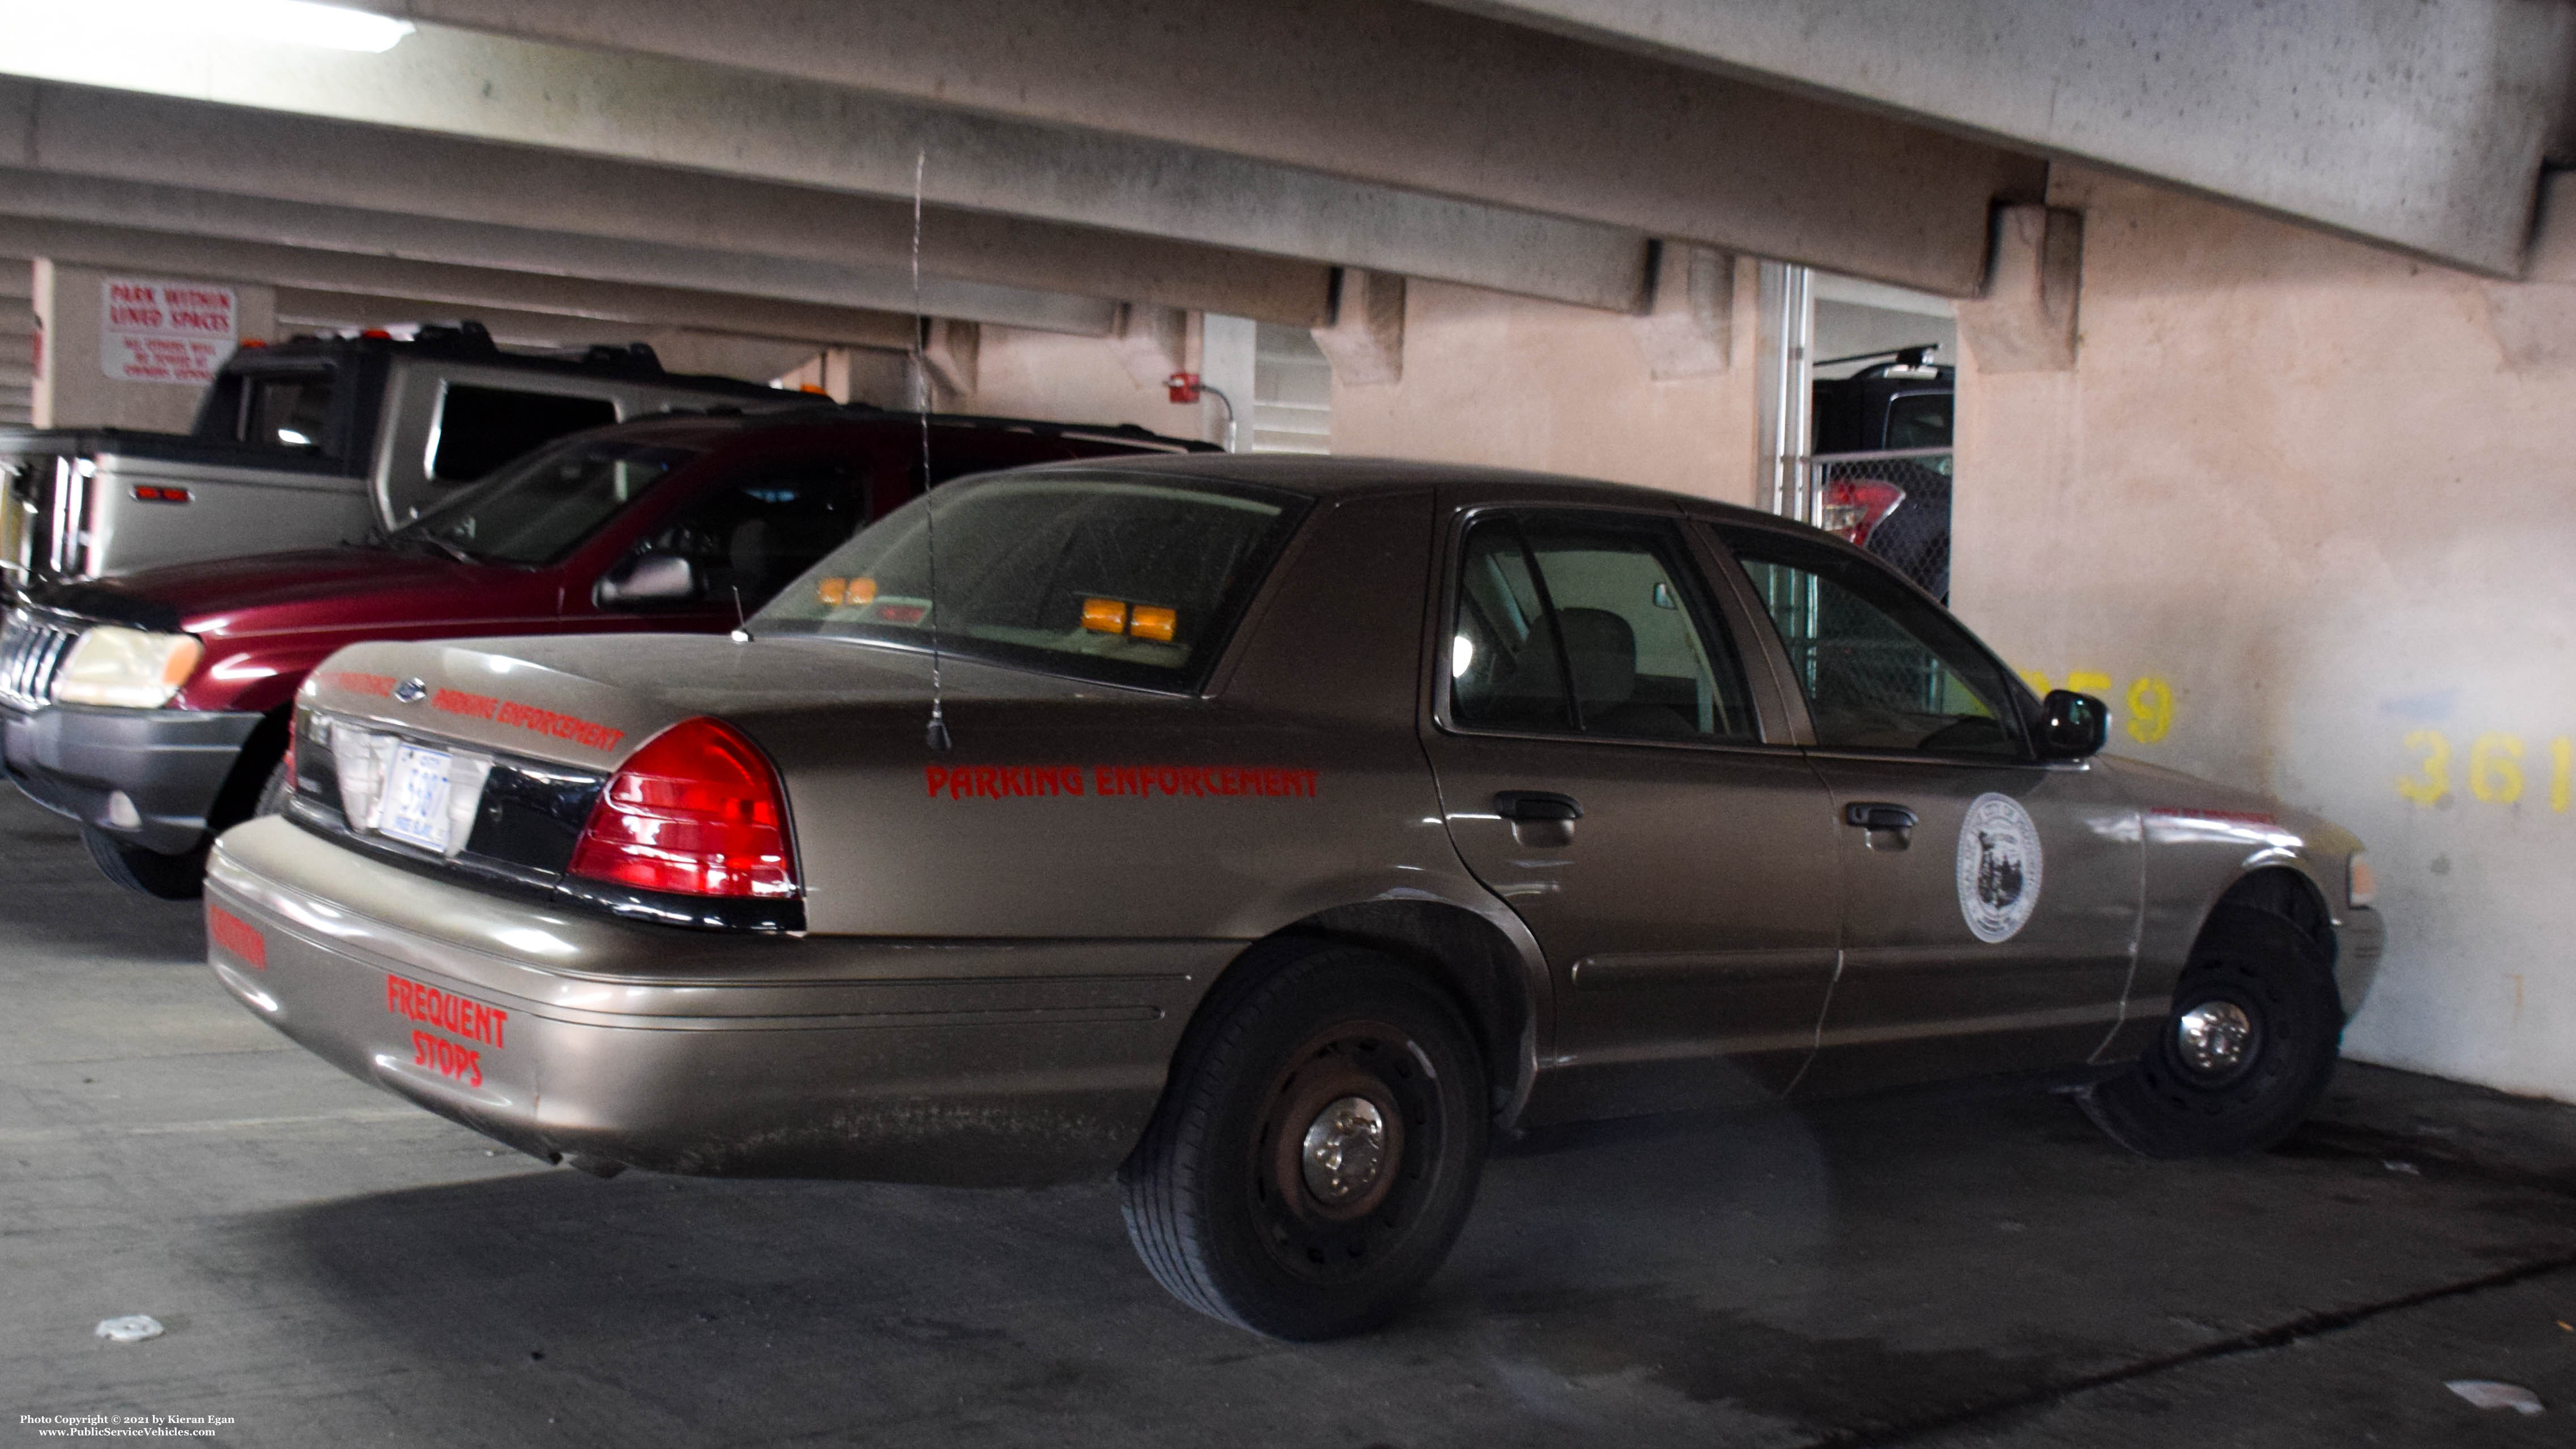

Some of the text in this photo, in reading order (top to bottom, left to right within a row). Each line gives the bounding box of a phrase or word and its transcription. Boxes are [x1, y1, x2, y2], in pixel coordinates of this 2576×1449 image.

[110, 284, 155, 303] PARK
[110, 305, 230, 331] LINED SPACES
[497, 701, 625, 752] ENFORCEMENT
[925, 765, 1318, 800] PARKING ENFORCEMENT
[2396, 730, 2573, 814] 361
[387, 974, 508, 1049] FREQUENT
[412, 1029, 483, 1088] STOPS
